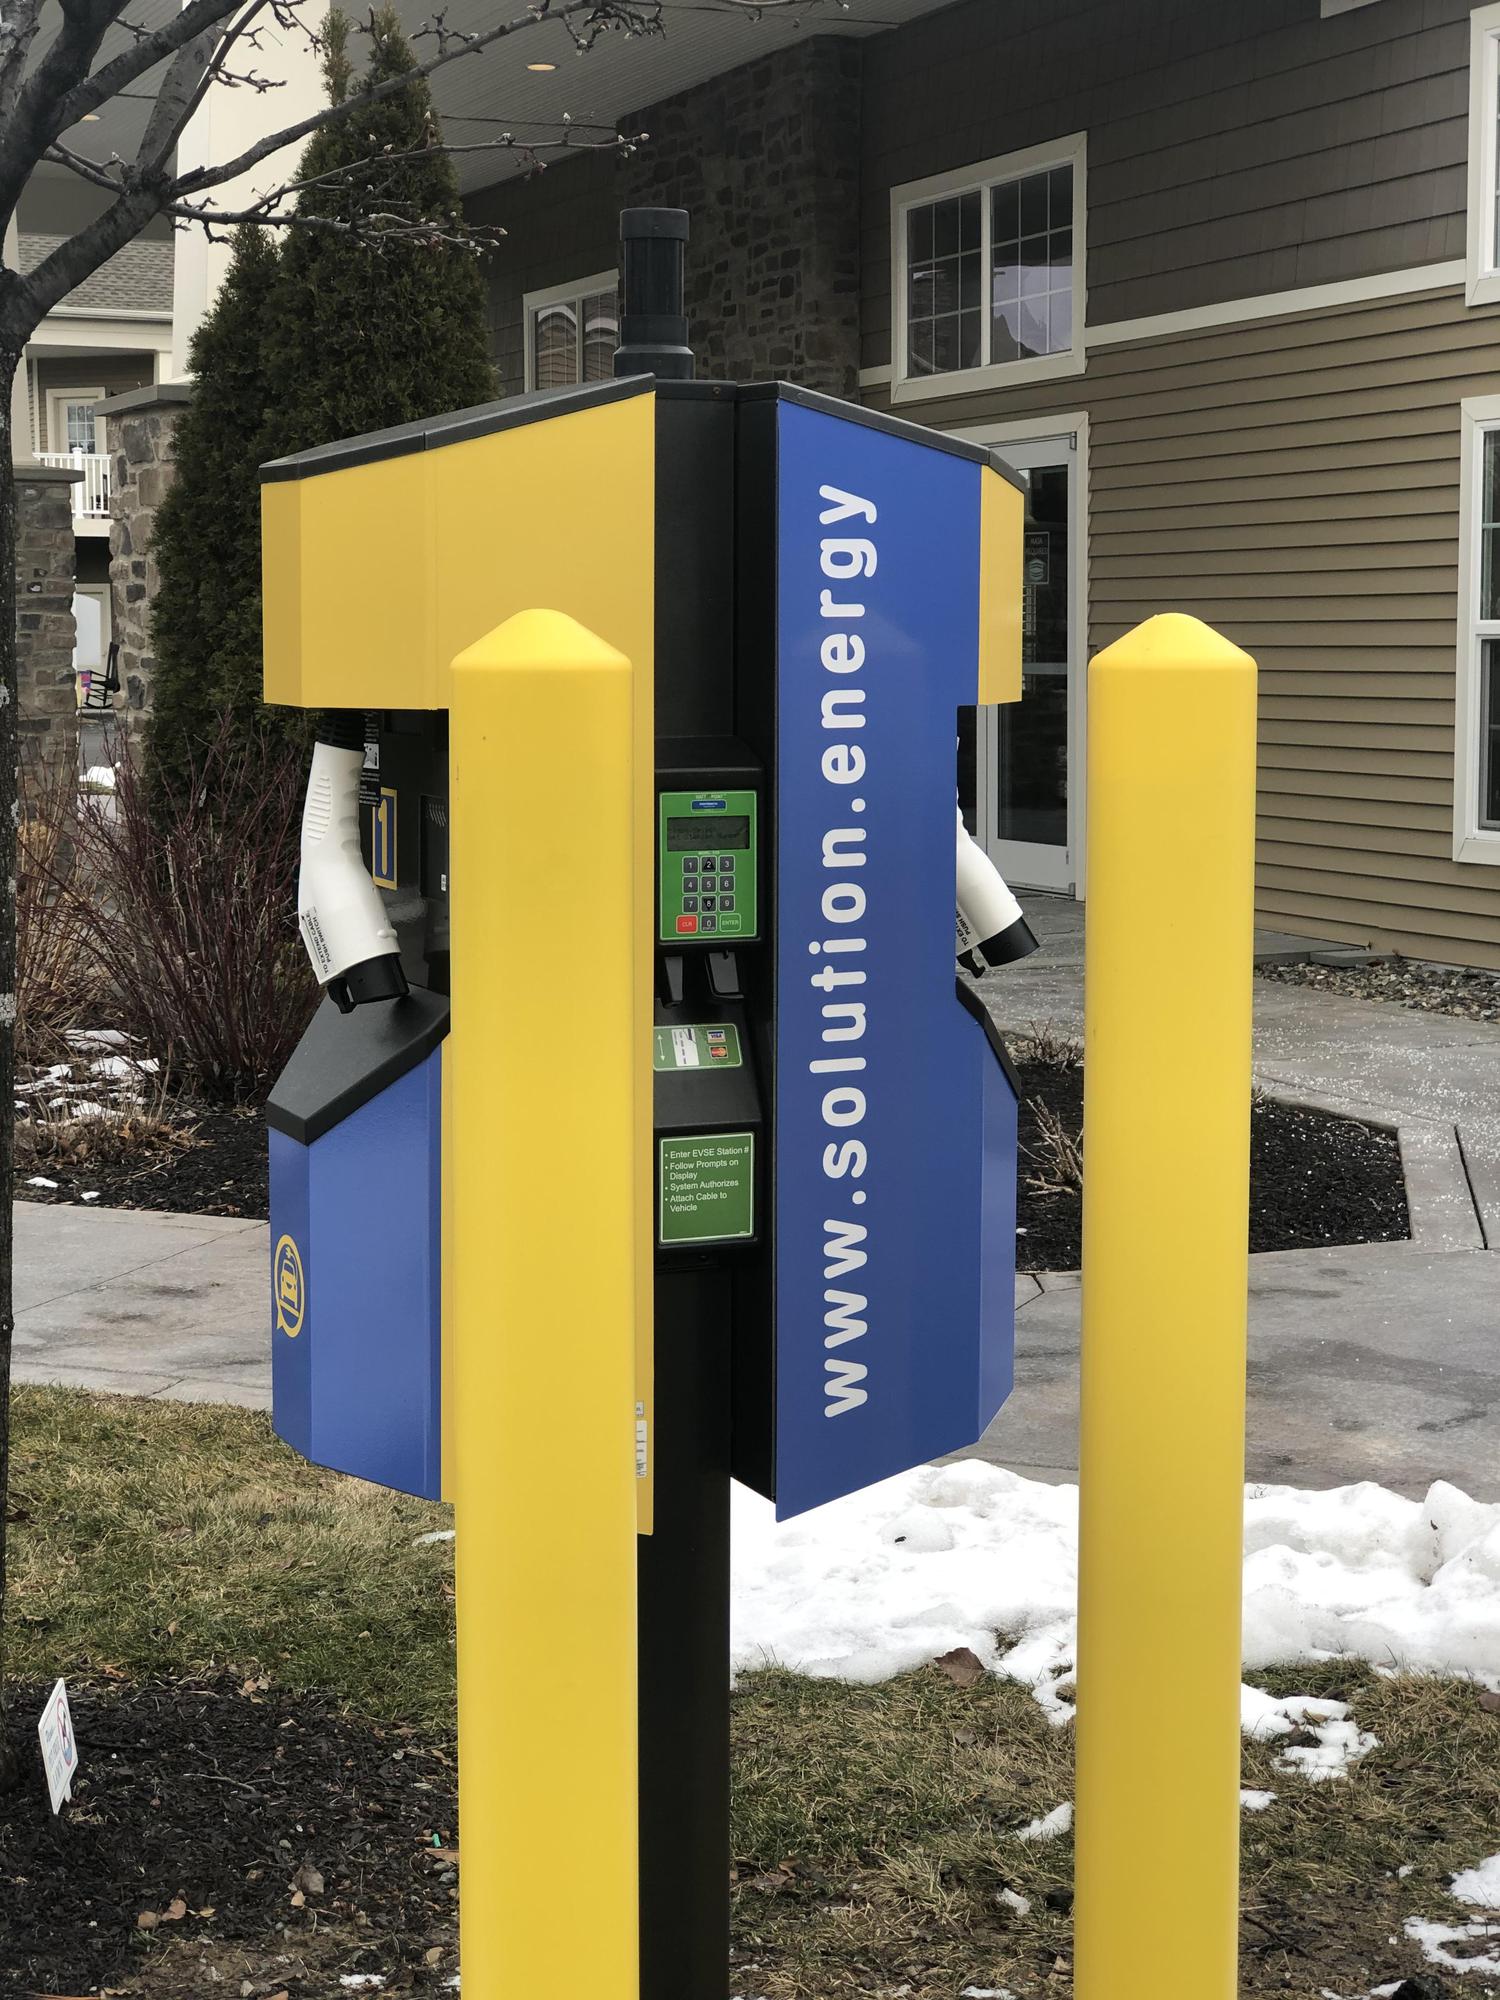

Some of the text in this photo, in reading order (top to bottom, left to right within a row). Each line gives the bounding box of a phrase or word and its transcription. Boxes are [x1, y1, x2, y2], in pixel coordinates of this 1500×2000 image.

[724, 860, 730, 868] 3
[688, 881, 693, 889] 4
[724, 899, 730, 907] 9
[706, 919, 712, 927] 0
[959, 918, 971, 935] PUSH
[312, 917, 332, 963] PUSH SWITCH
[961, 936, 969, 946] TO
[314, 936, 326, 964] EXTEND
[808, 484, 878, 1418] www.solution.energy
[323, 963, 329, 974] TO
[670, 1146, 750, 1159] Enter EVSE Station #
[669, 1162, 695, 1170] Follow
[696, 1160, 728, 1168] Prompts
[669, 1172, 698, 1181] Display
[669, 1180, 739, 1192] System Authorizes
[669, 1191, 728, 1203] Attach Cable to
[669, 1203, 698, 1212] Vehicle
